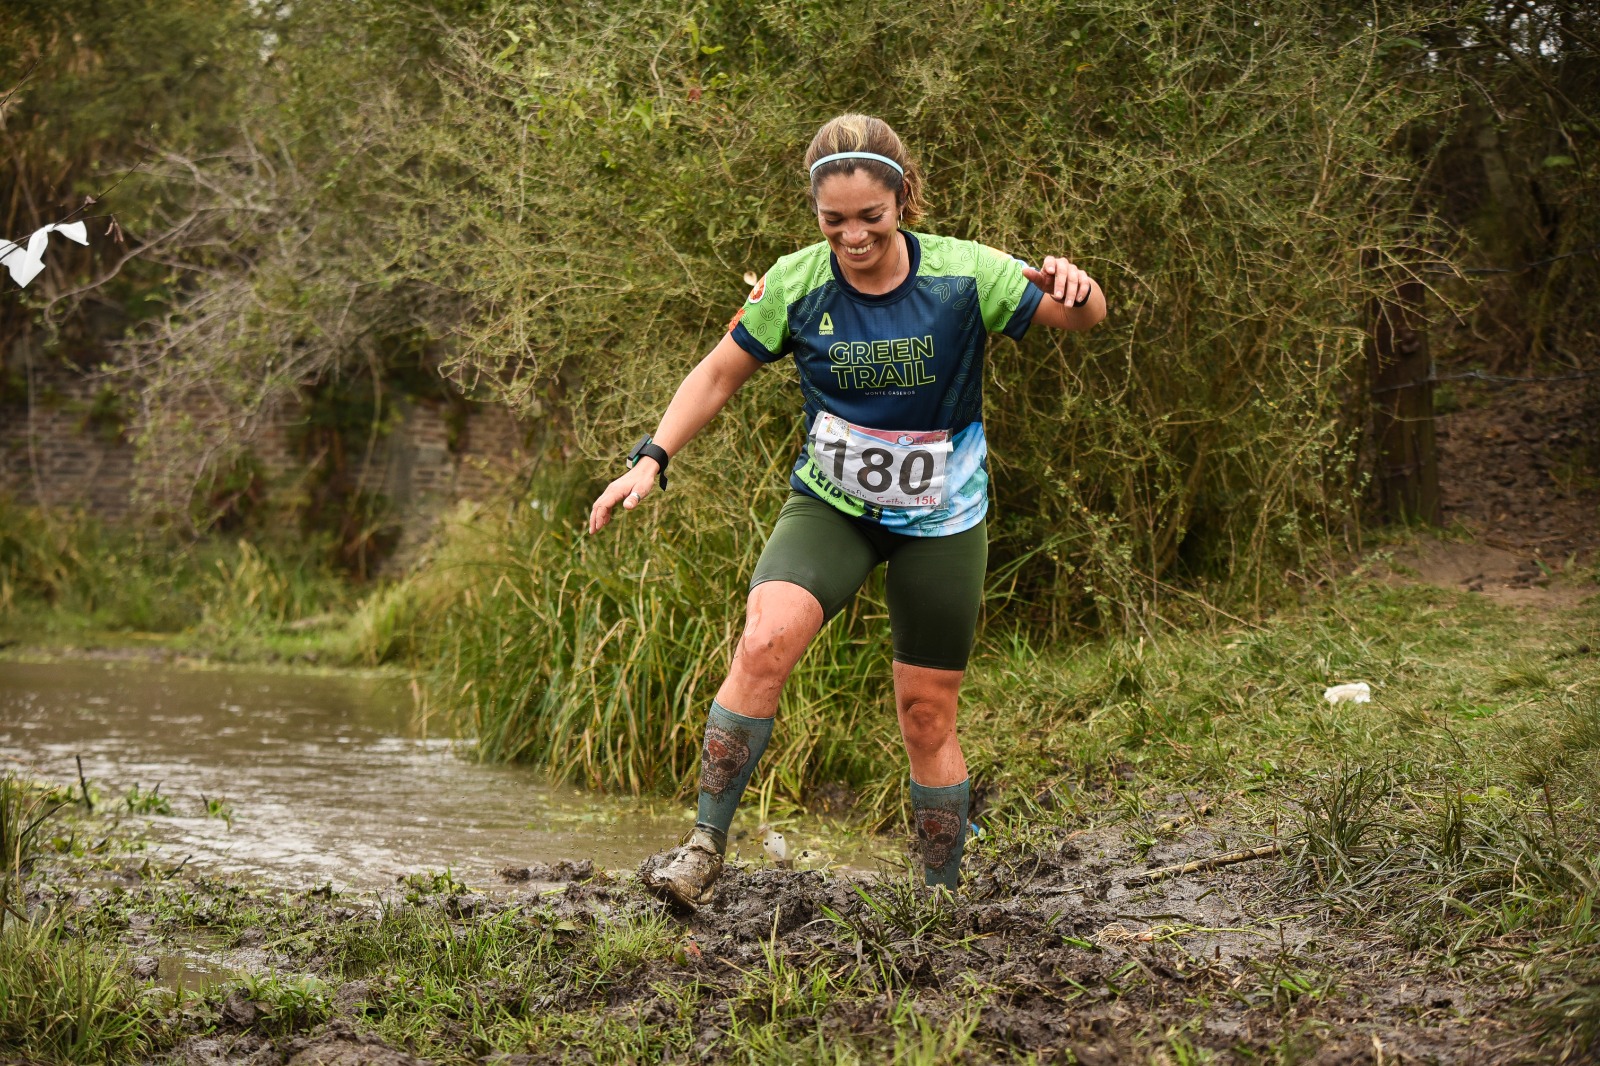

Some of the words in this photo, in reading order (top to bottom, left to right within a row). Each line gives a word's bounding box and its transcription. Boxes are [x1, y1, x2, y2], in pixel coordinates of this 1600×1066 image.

[829, 335, 934, 365] GREEN
[831, 361, 936, 389] TRAIL
[823, 439, 934, 495] 180
[914, 495, 937, 505] 15k
